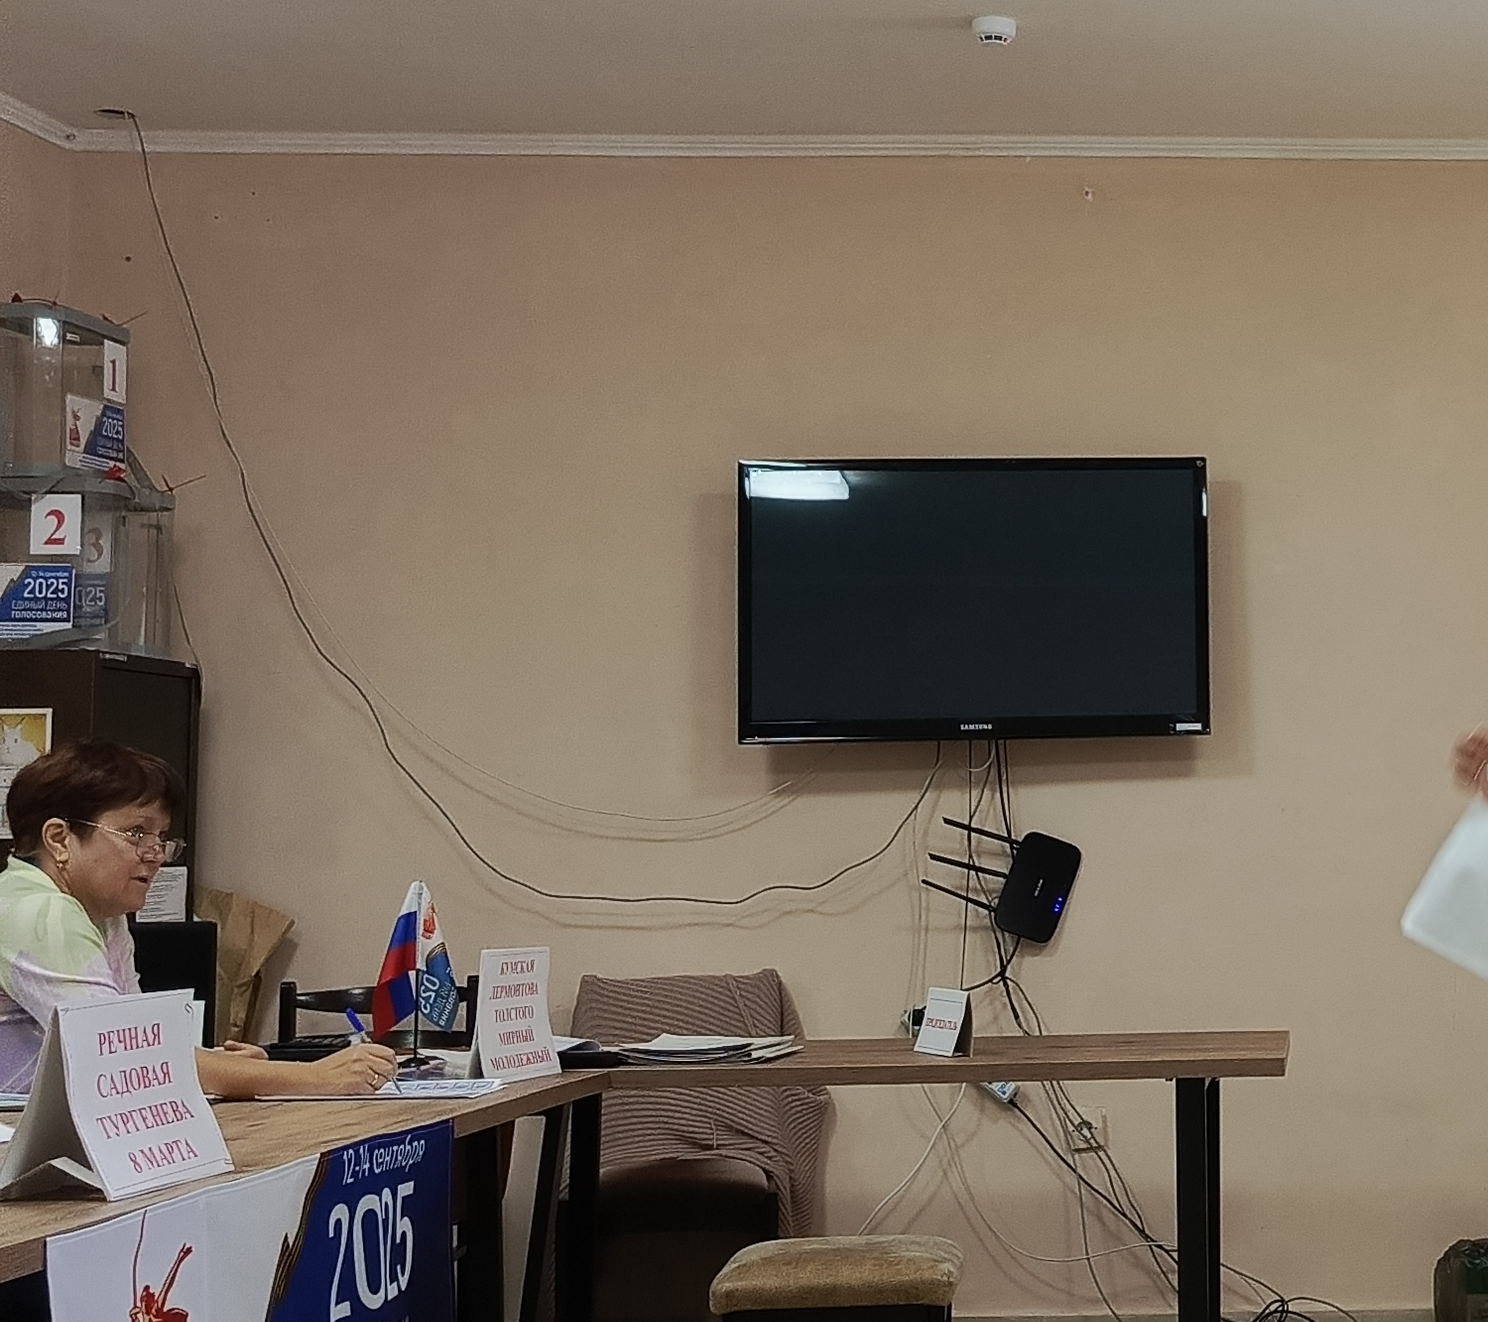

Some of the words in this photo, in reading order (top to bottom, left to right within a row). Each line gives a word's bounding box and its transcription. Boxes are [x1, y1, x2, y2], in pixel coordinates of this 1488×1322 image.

[108, 358, 119, 394] 1
[102, 416, 124, 439] 2025
[42, 509, 67, 546] 2
[86, 527, 104, 564] 3
[23, 578, 69, 598] 2025
[75, 587, 105, 606] 025
[494, 1005, 534, 1023] ТОЛСТОГО
[97, 1022, 162, 1056] РЕЧНАЯ
[498, 1025, 535, 1046] МИРНЫЙ
[96, 1061, 173, 1099] САДОВАЯ
[96, 1099, 195, 1140] ТУРГЕНЕВА
[128, 1151, 143, 1174] 8
[139, 1138, 198, 1170] МАРТА
[342, 1143, 370, 1185] 12-14
[373, 1134, 425, 1174] сентября
